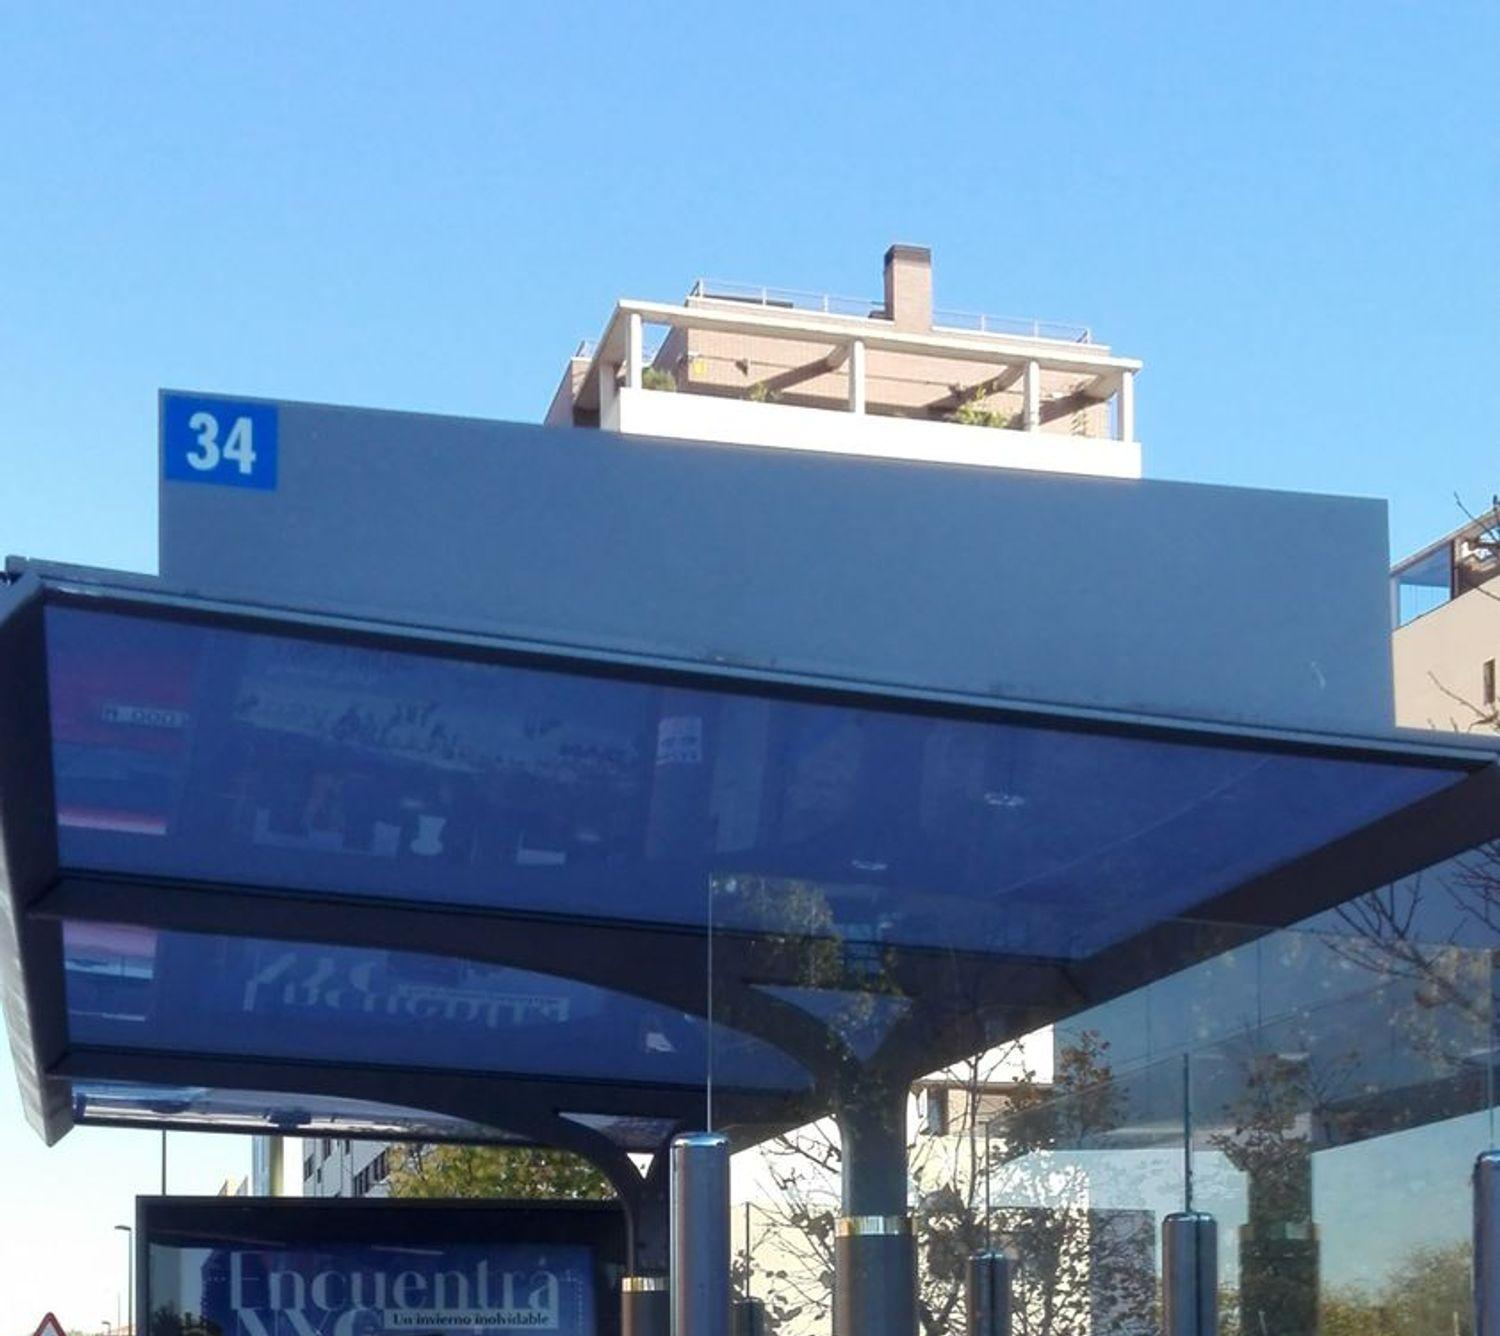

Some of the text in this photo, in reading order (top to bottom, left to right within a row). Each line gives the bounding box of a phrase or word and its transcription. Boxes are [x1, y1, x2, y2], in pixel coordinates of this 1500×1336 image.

[187, 412, 256, 474] 34
[394, 1313, 550, 1325] Un invierno inolvidable
